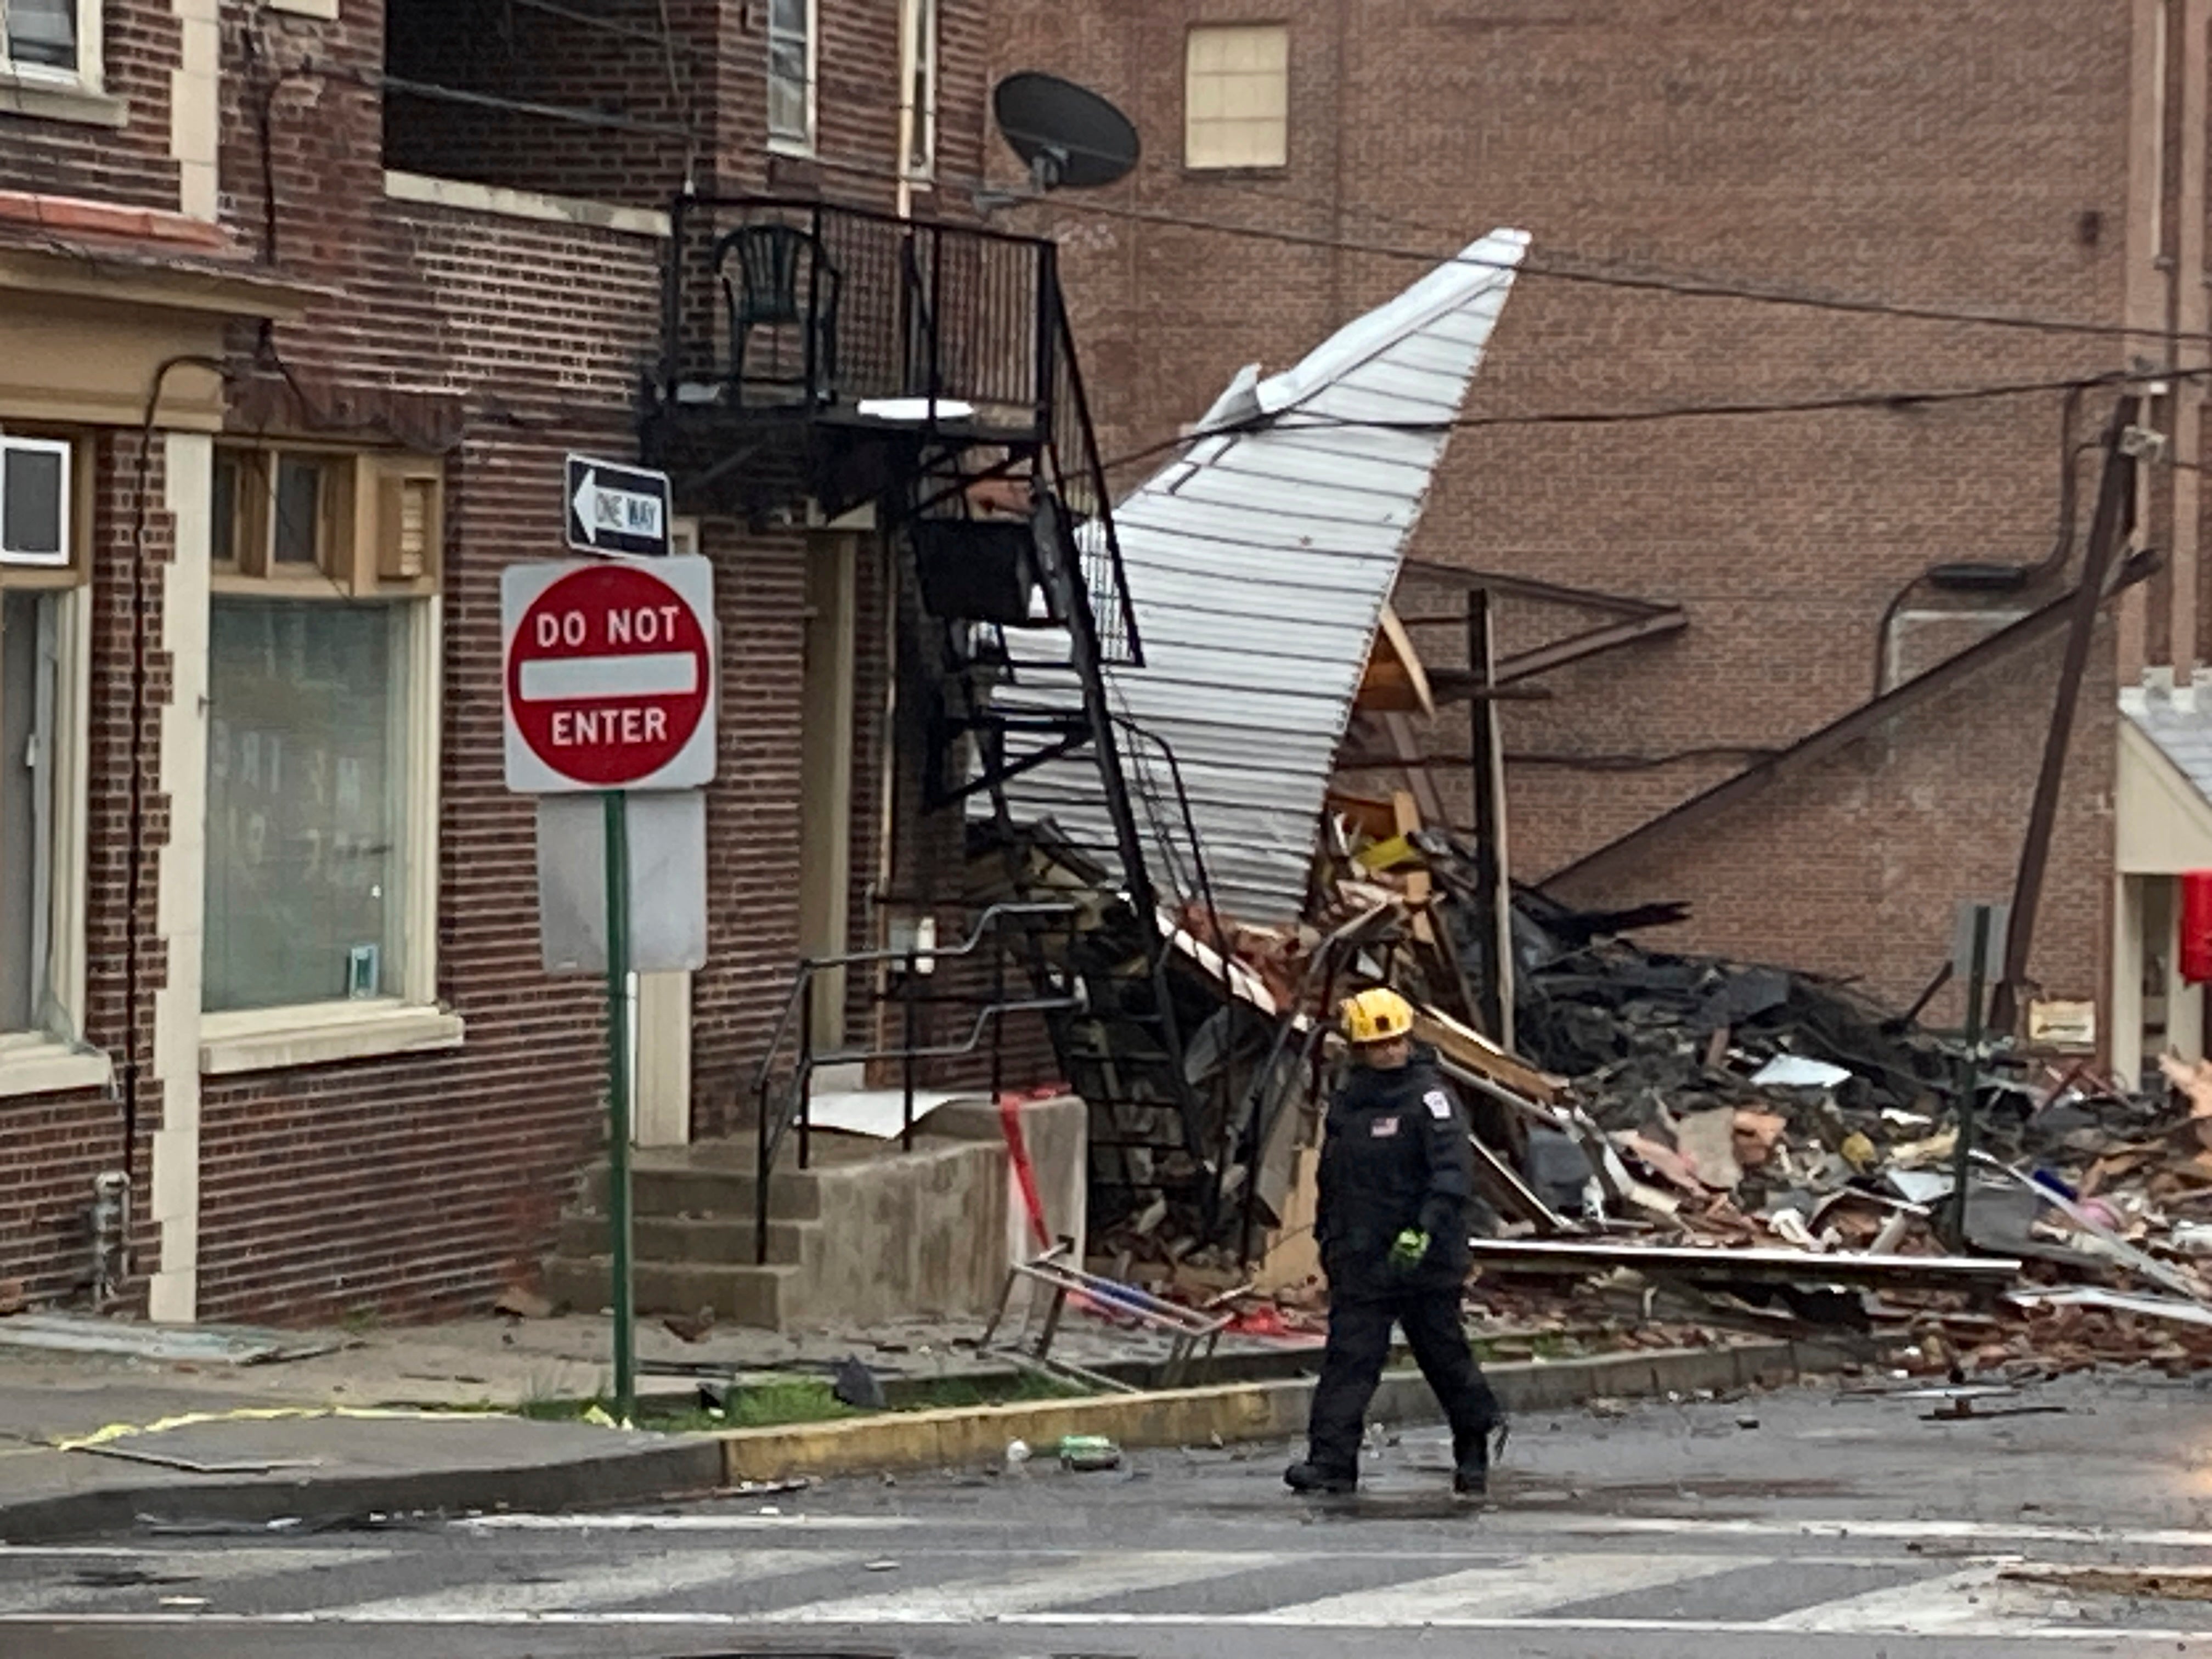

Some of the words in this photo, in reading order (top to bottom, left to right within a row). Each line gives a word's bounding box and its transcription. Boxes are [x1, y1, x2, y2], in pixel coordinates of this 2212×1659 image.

[596, 492, 623, 527] ONE
[627, 497, 656, 532] WAY
[536, 611, 586, 647] DO
[607, 606, 680, 644] NOT
[552, 708, 667, 746] ENTER
